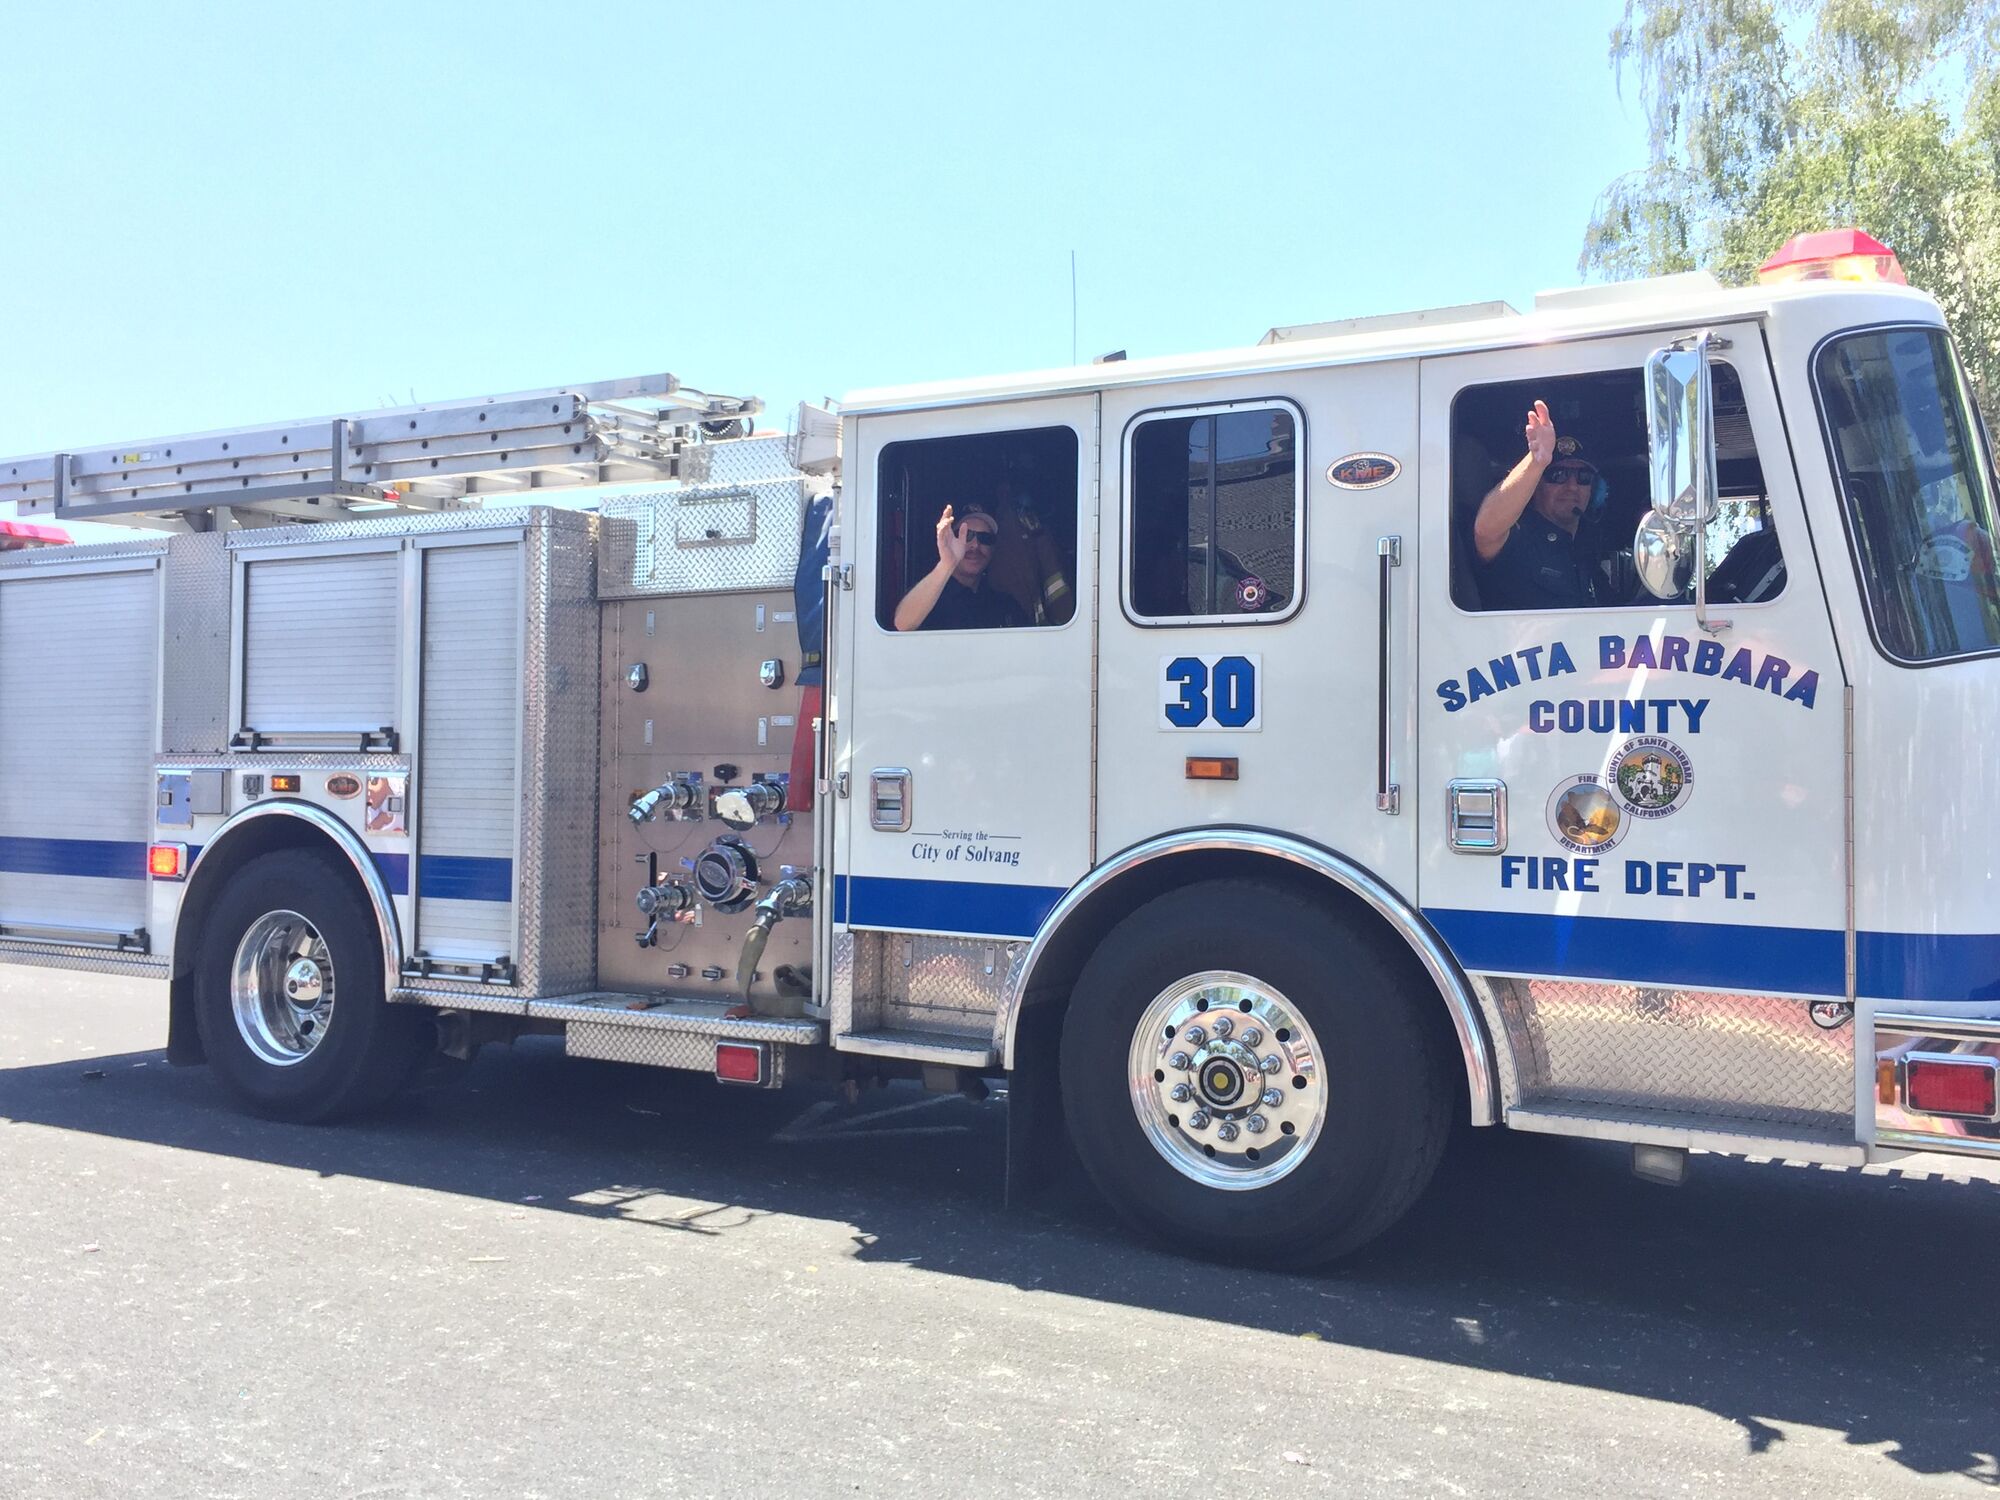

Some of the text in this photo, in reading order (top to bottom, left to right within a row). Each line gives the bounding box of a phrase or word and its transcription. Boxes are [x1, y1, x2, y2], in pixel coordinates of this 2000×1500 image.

[1340, 465, 1386, 480] KME
[1436, 635, 1820, 712] SANTA BARBARA
[1164, 656, 1255, 727] 30
[1528, 698, 1710, 734] COUNTY
[1608, 738, 1692, 784] COUNTY OF SANTA BARBARA
[1577, 775, 1598, 784] FIRE
[1623, 802, 1677, 817] CALIFORNIA
[942, 829, 988, 842] Serving the
[1560, 837, 1616, 854] DEPARTMENT
[912, 843, 1020, 867] City of Solvang
[1501, 855, 1756, 900] FIRE DEPT.
